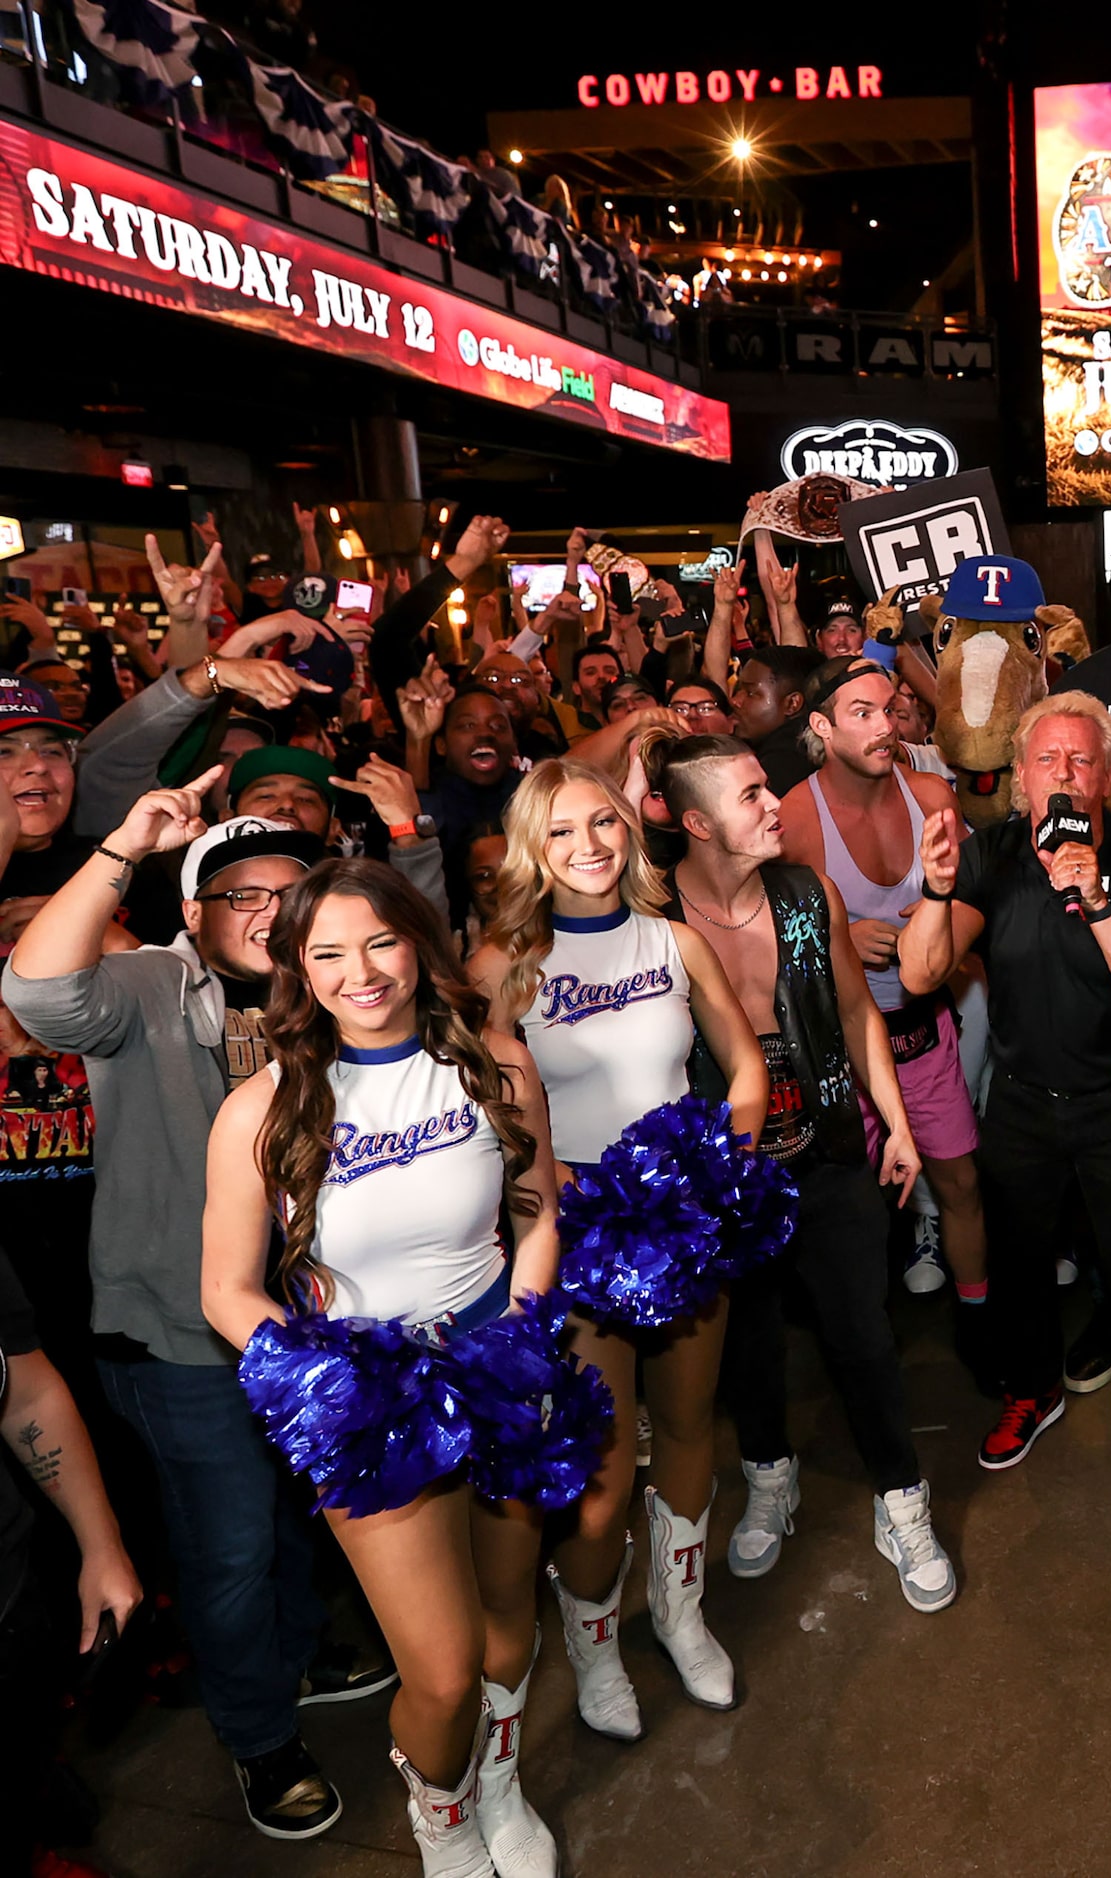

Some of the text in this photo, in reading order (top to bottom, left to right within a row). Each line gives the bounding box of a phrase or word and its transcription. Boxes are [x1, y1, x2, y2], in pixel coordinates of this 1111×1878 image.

[577, 65, 883, 107] COWBOY BAR
[26, 167, 436, 354] SATURDAY, JULY 12
[479, 337, 595, 402] Globe Life Field
[797, 333, 992, 368] RAM
[977, 566, 1011, 606] T
[1038, 817, 1054, 848] AEW
[1058, 817, 1089, 833] AEW
[541, 963, 674, 1023] Rangers
[322, 1100, 478, 1173] Rangers
[674, 1542, 705, 1588] T
[582, 1610, 618, 1646] T
[488, 1713, 522, 1766] T
[430, 1799, 470, 1831] T
